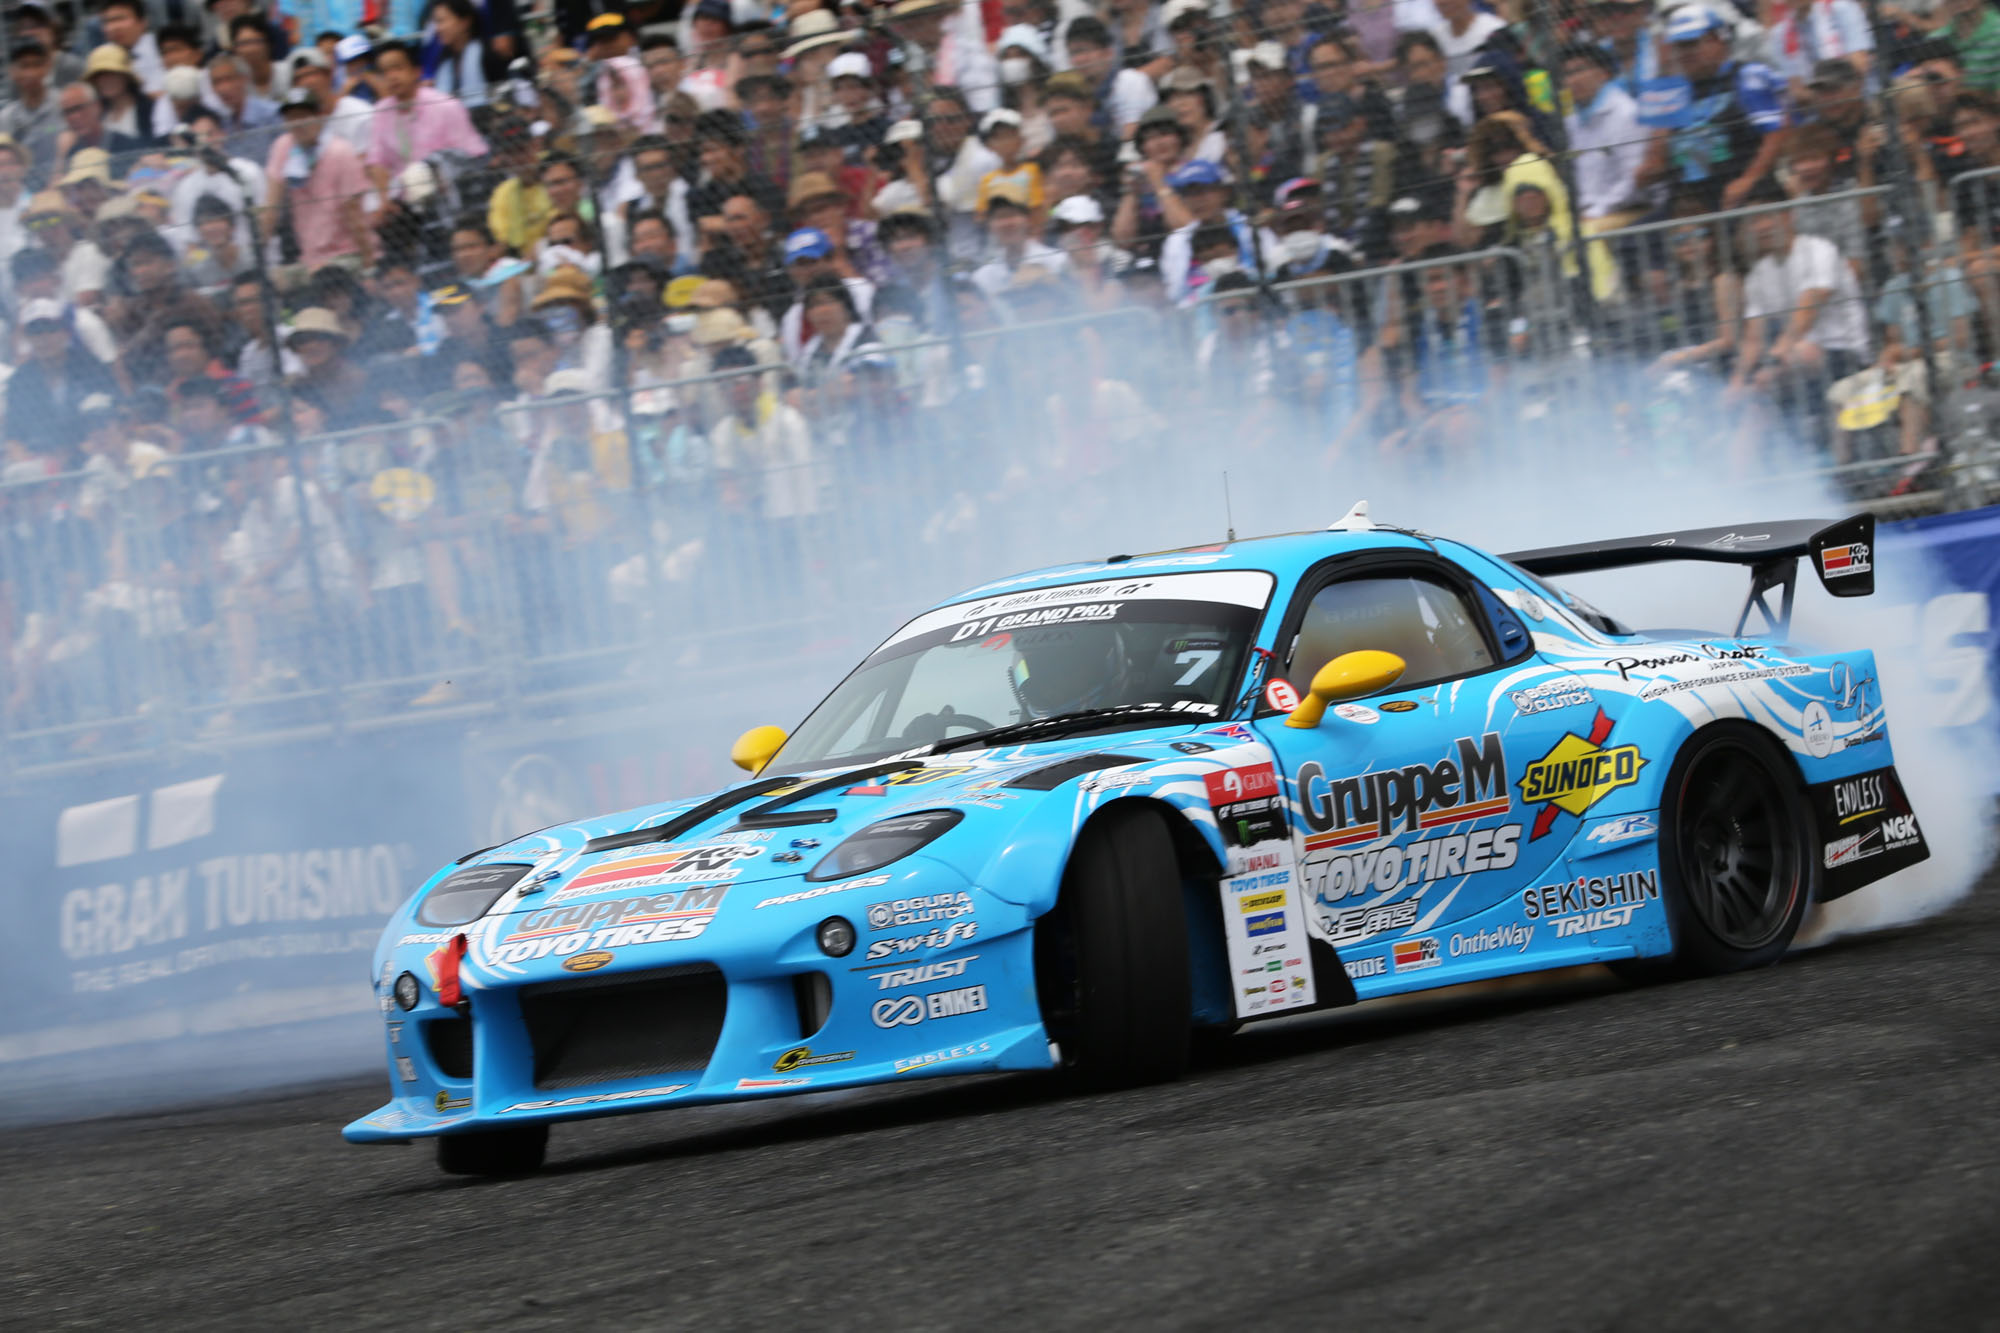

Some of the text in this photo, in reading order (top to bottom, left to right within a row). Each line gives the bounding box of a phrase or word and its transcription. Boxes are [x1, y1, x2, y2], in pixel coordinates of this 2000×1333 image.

[1002, 585, 1109, 608] GRAN TURISMO
[950, 617, 1000, 643] D1
[996, 606, 1069, 629] GRAND
[1069, 603, 1125, 620] PRIX
[1174, 650, 1223, 686] 7
[1605, 650, 1700, 681] Power
[1641, 663, 1811, 701] HIGH PERFORMANCE EXHAUST SYSTEM
[1708, 660, 1743, 671] JAPAN
[1272, 683, 1295, 710] E
[1533, 690, 1594, 712] CLUTCH
[1243, 771, 1278, 791] GLION
[1298, 731, 1509, 837] GruppeM
[1526, 750, 1634, 798] SUNOCO
[1834, 775, 1885, 818] ENDLESS
[1882, 813, 1918, 843] NGK
[663, 846, 763, 874] K&N
[1304, 845, 1402, 905] TOYO
[1403, 823, 1523, 887] TIRES
[197, 844, 398, 932] TURISMO
[552, 868, 741, 901] PERFORMANCE FILTERS
[754, 874, 892, 910] PROXES
[891, 891, 971, 913] OGURA
[517, 882, 734, 932] GruppeM
[893, 902, 975, 927] CLUTCH
[1546, 903, 1646, 938] TRUST
[487, 930, 592, 967] TOYO
[588, 917, 714, 951] TIRES
[866, 921, 979, 961] Swift
[1449, 921, 1535, 957] OntheWay
[868, 954, 981, 990] TRUST
[1344, 956, 1388, 979] RIDE
[926, 984, 988, 1020] ENKEI
[893, 1042, 991, 1070] ENDLESS
